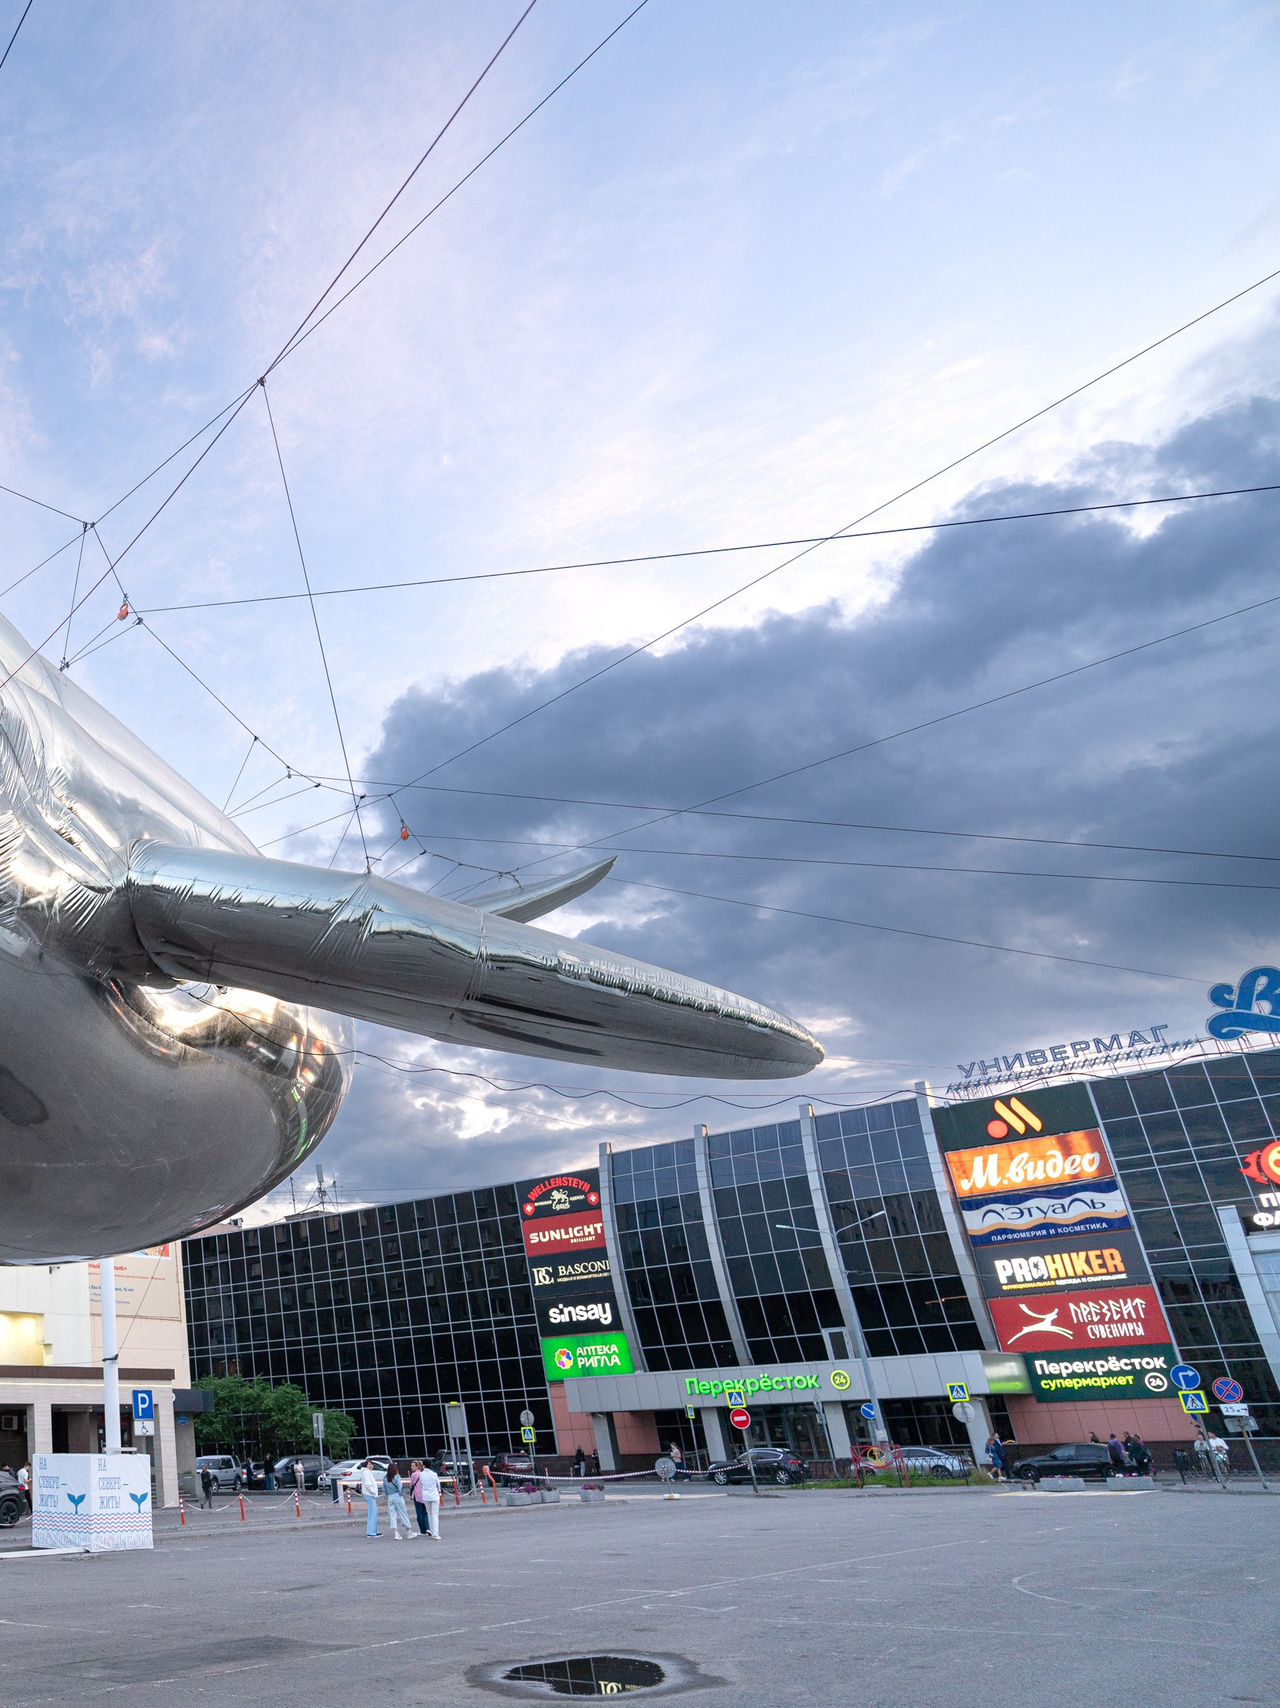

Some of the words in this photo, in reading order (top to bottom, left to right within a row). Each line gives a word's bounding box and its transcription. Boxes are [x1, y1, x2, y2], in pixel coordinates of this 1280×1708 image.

[957, 1024, 1168, 1078] УНИВЕРМАГ
[960, 1149, 1101, 1190] М.видео
[527, 1176, 591, 1201] WELLENSTEYN
[529, 1222, 603, 1244] SUNLIGHT
[991, 1228, 1047, 1242] ПАРФЮМЕРИЯ
[1057, 1222, 1108, 1234] КОСМЕТИКА
[557, 1260, 610, 1276] BASCONI
[994, 1248, 1126, 1284] PROHIKER
[549, 1302, 613, 1325] sinsay
[1087, 1321, 1145, 1339] СУВЕНИРЫ
[576, 1344, 619, 1356] АПТЕКА
[577, 1354, 621, 1368] РИГЛА
[1034, 1356, 1168, 1377] Перекрёсток
[685, 1373, 821, 1398] Перекрёсток
[834, 1376, 848, 1385] 24
[1041, 1375, 1134, 1391] супермаркет
[1149, 1377, 1163, 1387] 24
[138, 1393, 149, 1417] P
[98, 1458, 107, 1471] НА
